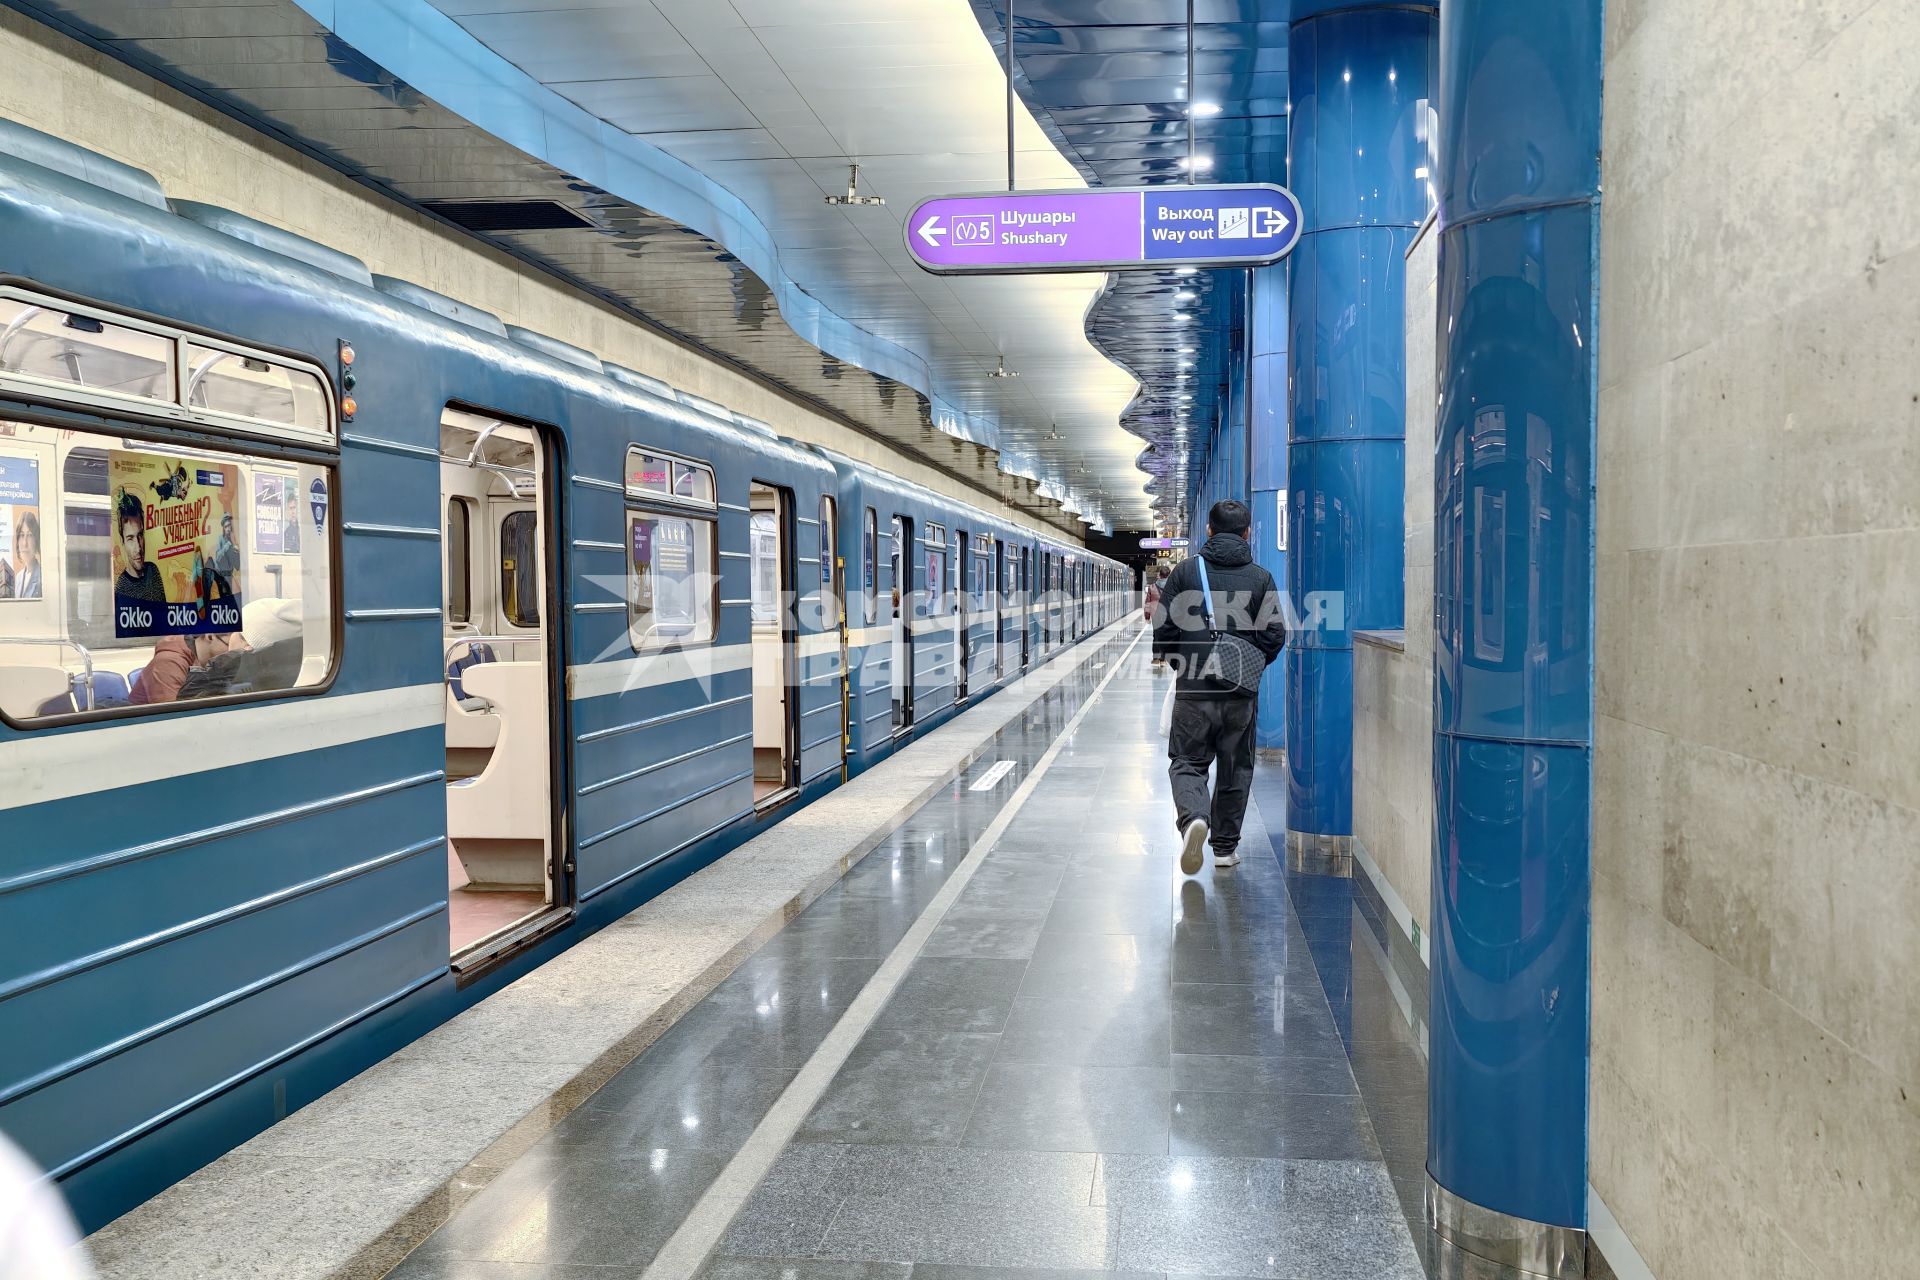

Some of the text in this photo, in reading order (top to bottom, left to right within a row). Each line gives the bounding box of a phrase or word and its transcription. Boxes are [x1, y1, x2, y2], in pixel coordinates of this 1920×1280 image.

[1001, 210, 1076, 227] Шушары
[1158, 206, 1214, 221] Выход
[979, 221, 990, 239] 5
[1152, 228, 1214, 243] Way out
[1001, 231, 1068, 246] Shushary
